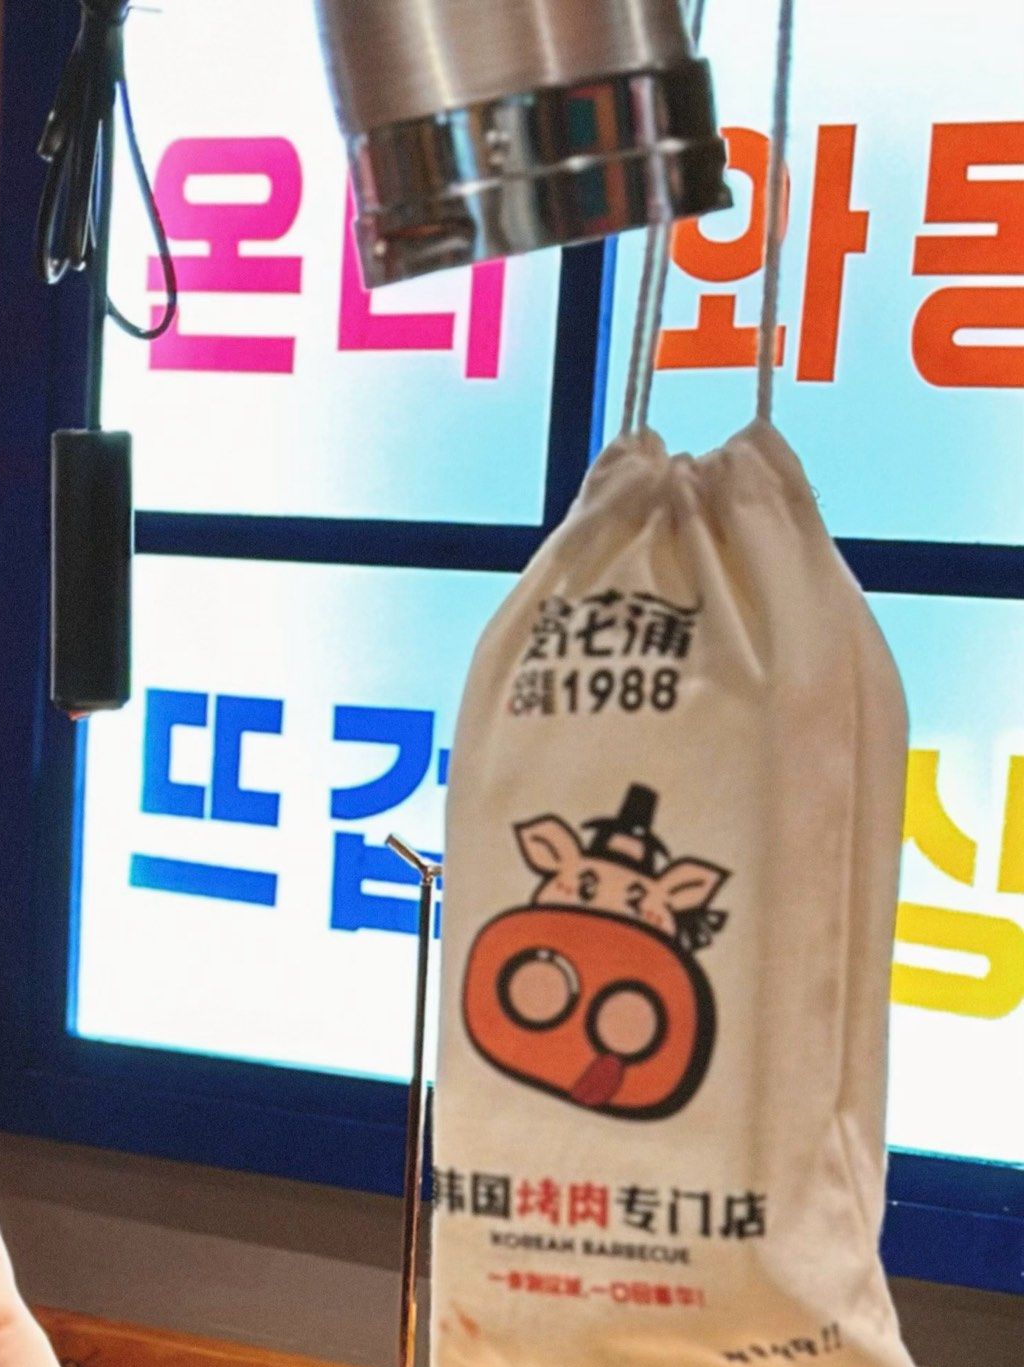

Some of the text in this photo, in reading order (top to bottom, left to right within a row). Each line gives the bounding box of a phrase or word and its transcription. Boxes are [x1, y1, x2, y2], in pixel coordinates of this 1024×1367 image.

[563, 665, 680, 716] 1988
[432, 1168, 766, 1240] 韩国烤肉专门店
[490, 1230, 690, 1266] KOREAN BARBECUE
